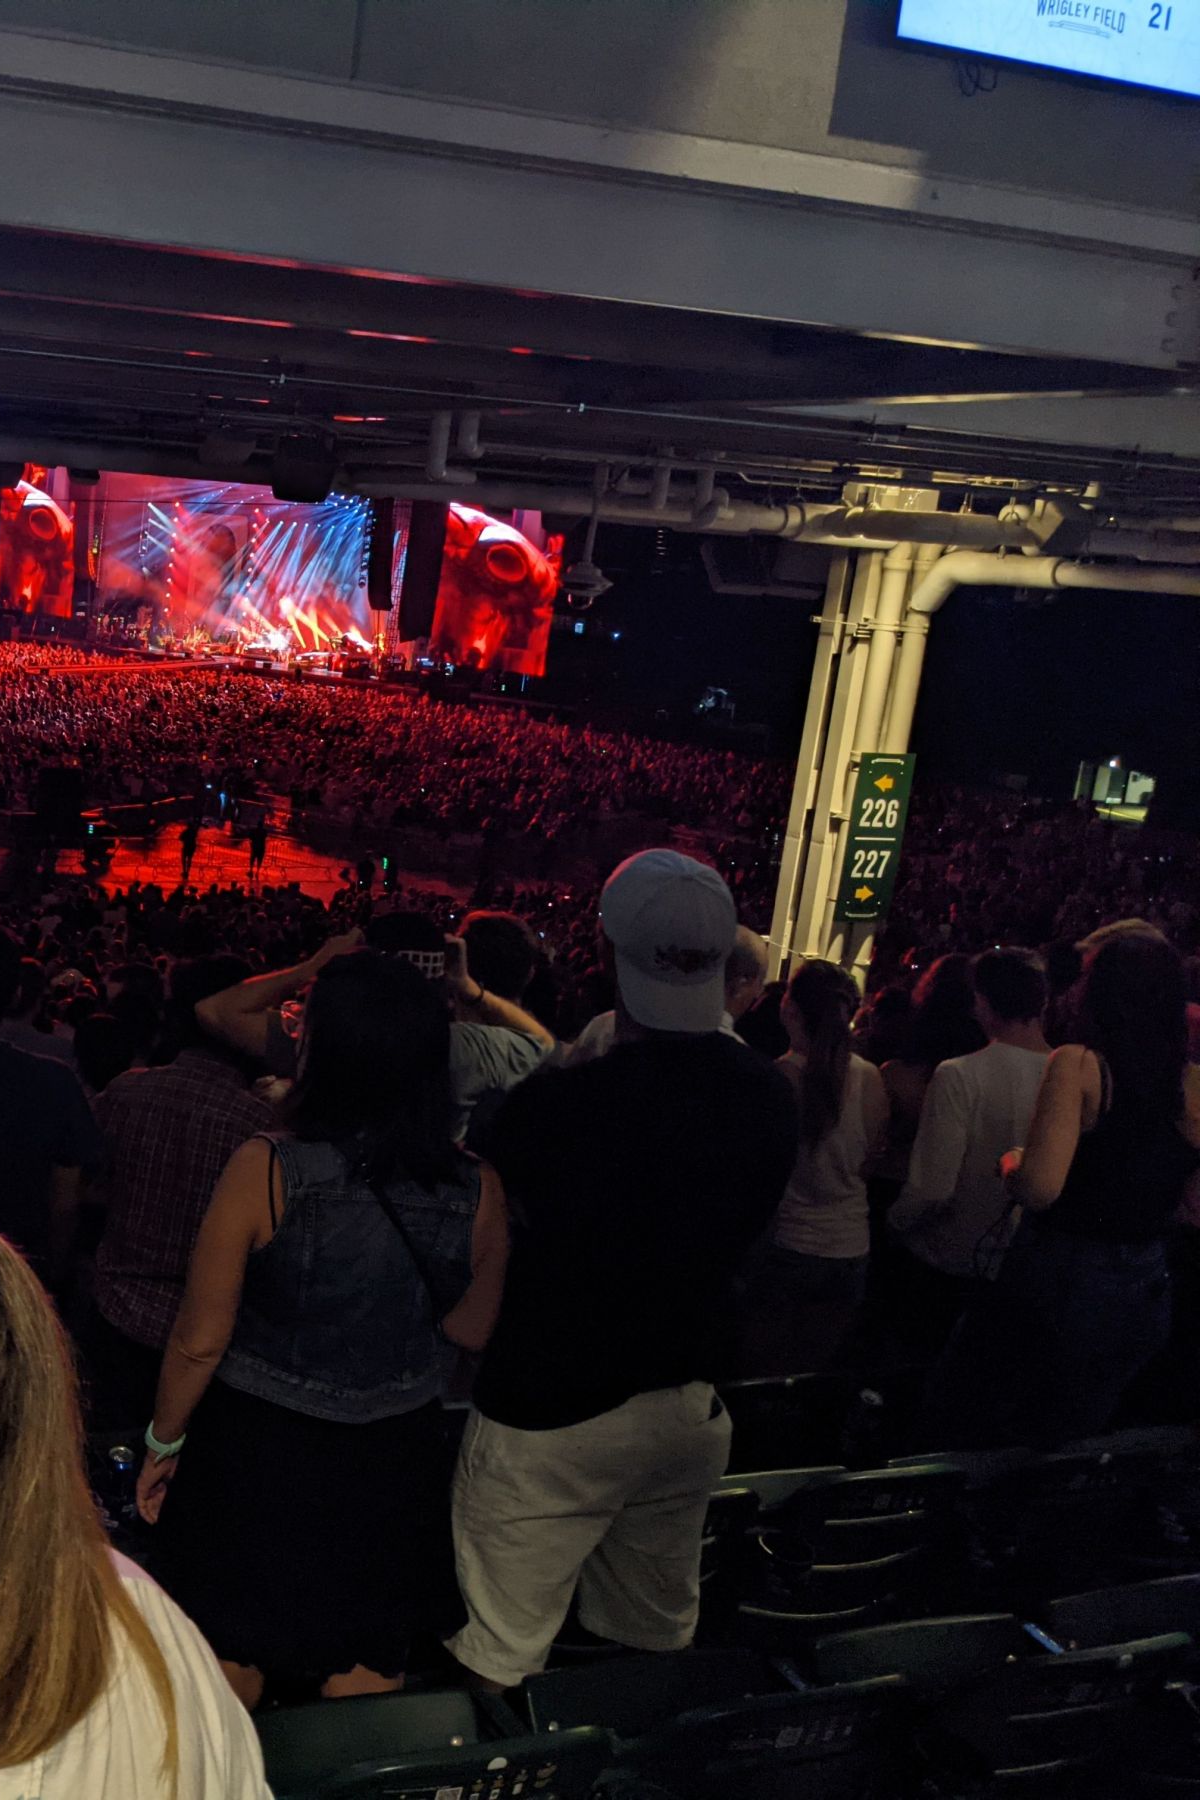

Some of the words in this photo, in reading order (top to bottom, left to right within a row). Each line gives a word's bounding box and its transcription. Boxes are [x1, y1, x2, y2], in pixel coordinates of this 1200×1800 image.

[1037, 0, 1090, 18] WRIGLEY
[1094, 7, 1126, 34] FIELD
[1148, 2, 1172, 31] 21
[859, 798, 900, 829] 226
[850, 850, 891, 879] 227
